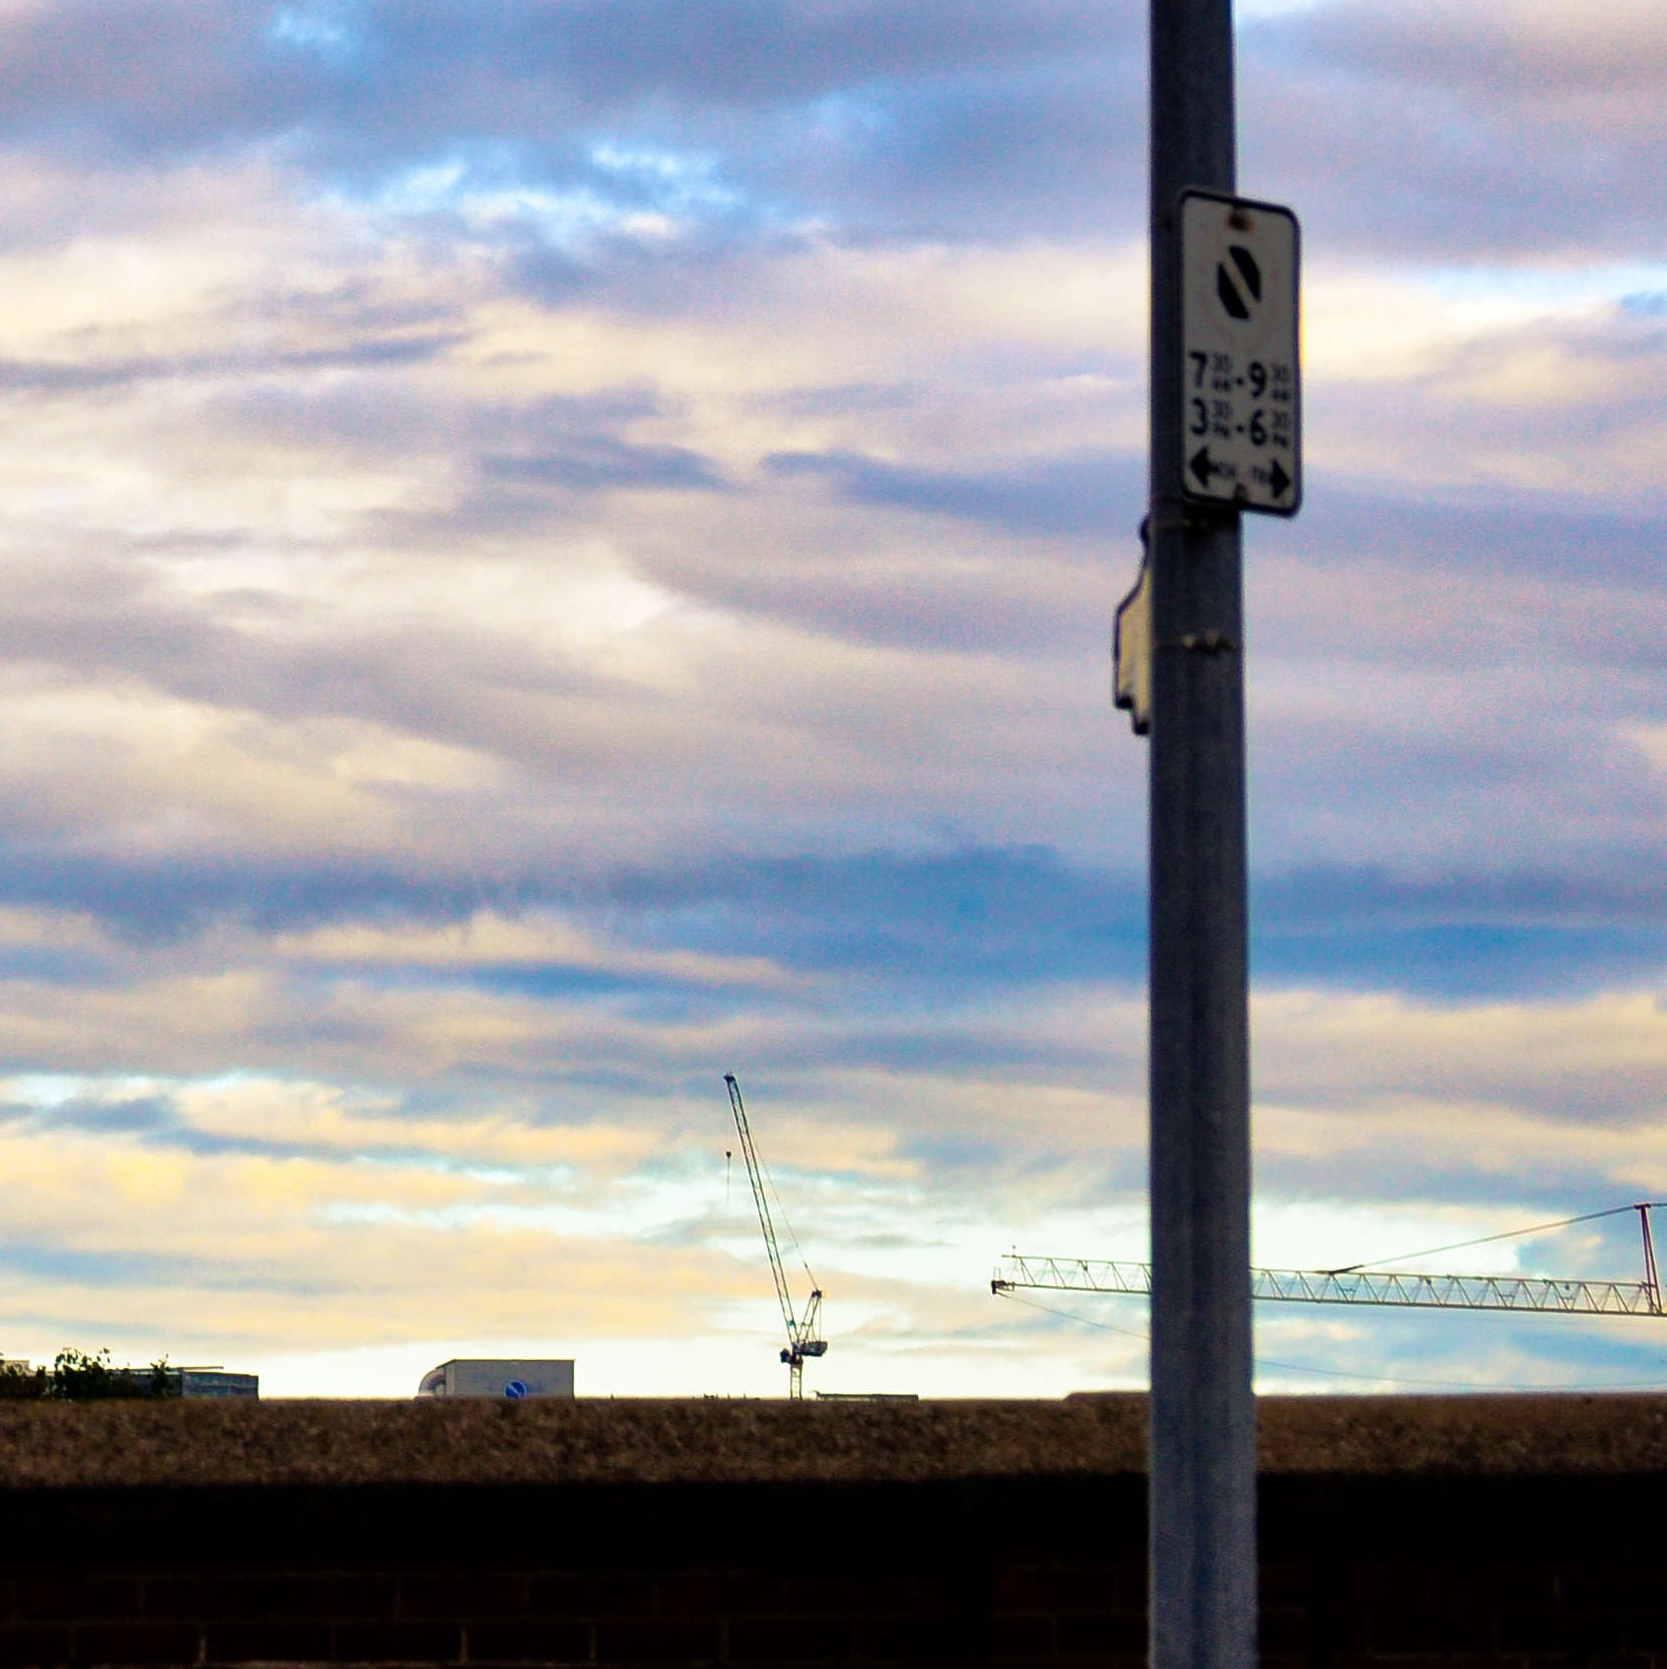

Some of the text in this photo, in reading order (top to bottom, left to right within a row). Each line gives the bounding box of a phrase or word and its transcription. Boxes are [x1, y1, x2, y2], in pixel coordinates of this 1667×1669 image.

[1189, 350, 1208, 388] 7
[1248, 360, 1267, 399] 9
[1190, 397, 1208, 436] 3
[1249, 408, 1267, 446] 6
